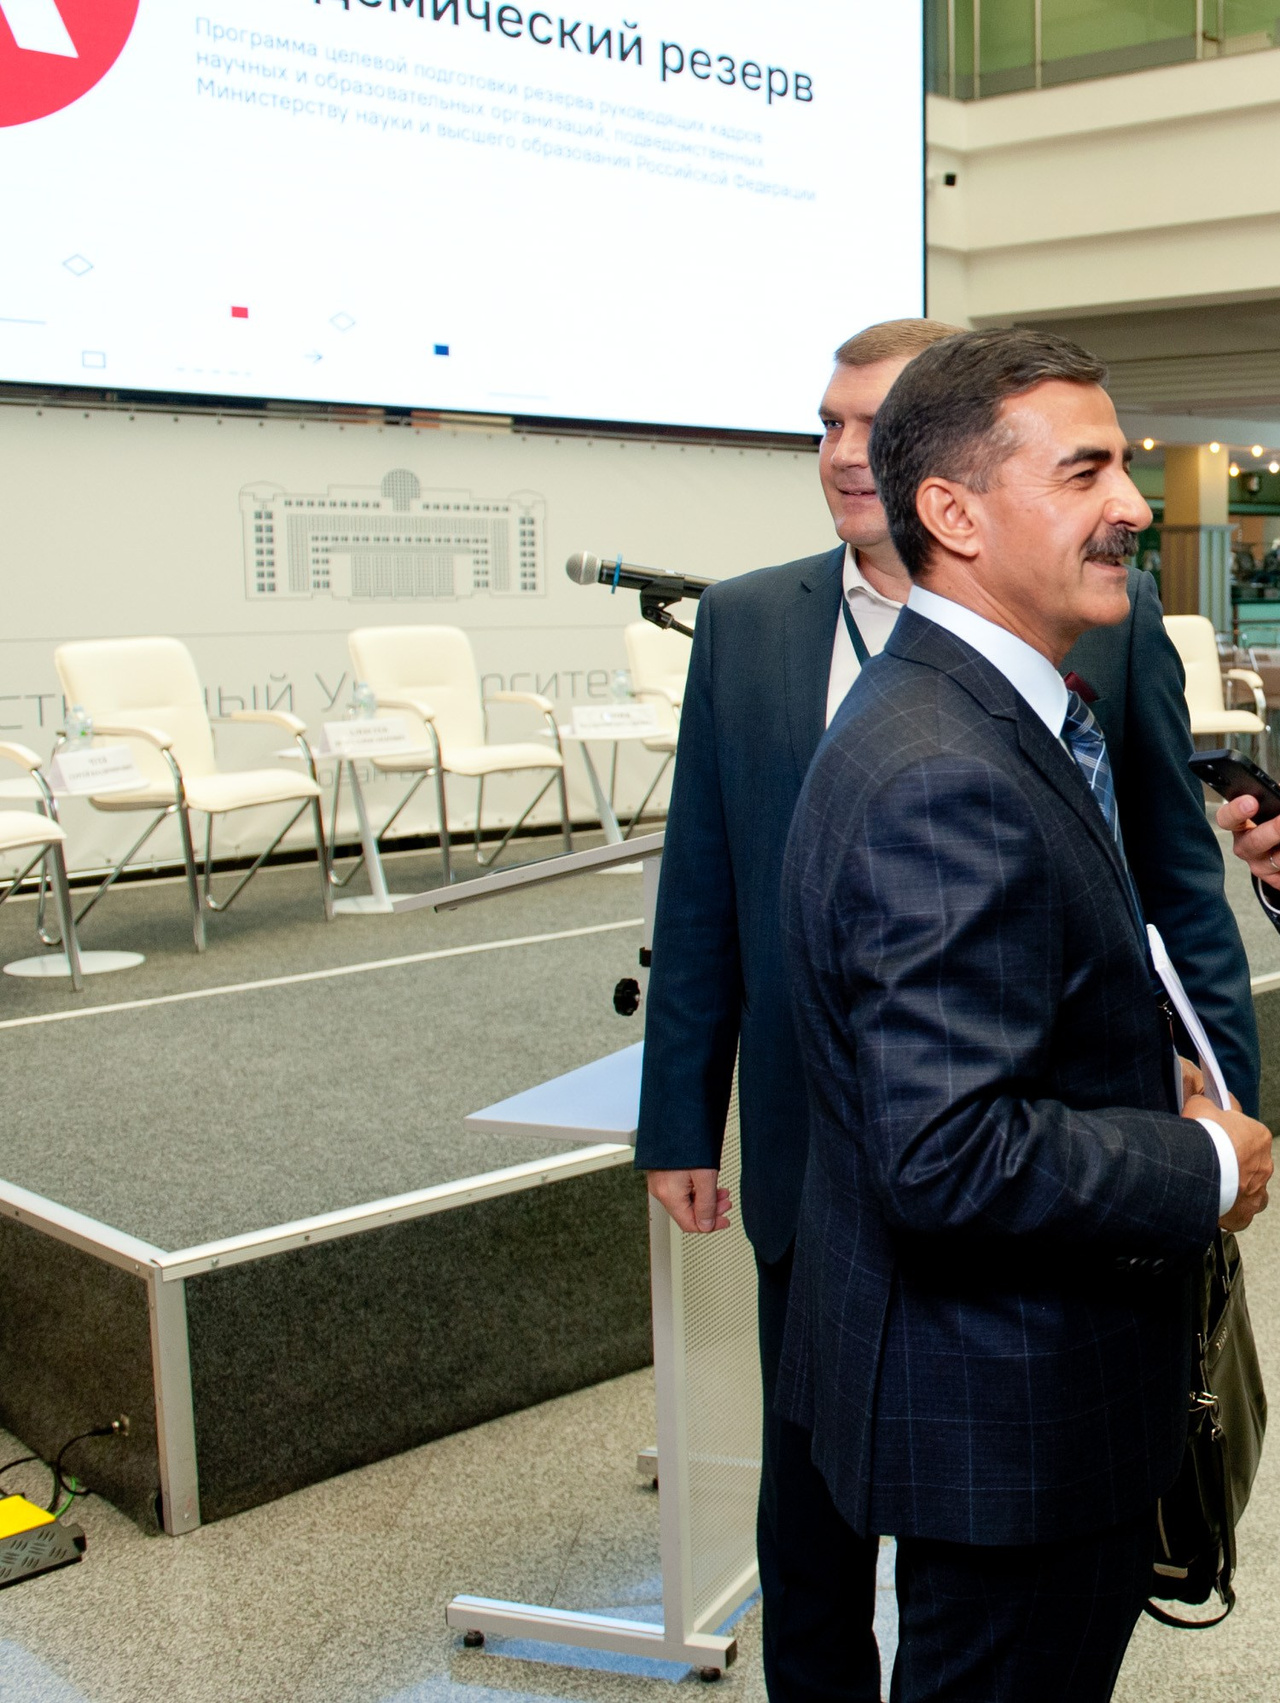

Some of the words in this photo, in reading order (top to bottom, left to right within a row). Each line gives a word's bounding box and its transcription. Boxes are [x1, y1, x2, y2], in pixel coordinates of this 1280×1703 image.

[195, 16, 318, 57] Программа
[326, 45, 408, 74] целевой
[415, 64, 518, 96] подготовки
[523, 84, 595, 113] резерва
[195, 50, 288, 81] научных
[296, 70, 308, 84] и
[315, 71, 484, 117] образовательных
[661, 40, 814, 105] резерв
[196, 77, 349, 124] Министерству
[356, 109, 414, 132] науки
[420, 120, 431, 134] и
[437, 123, 517, 149] высшего
[521, 137, 632, 170] образования
[636, 154, 729, 187] Российской
